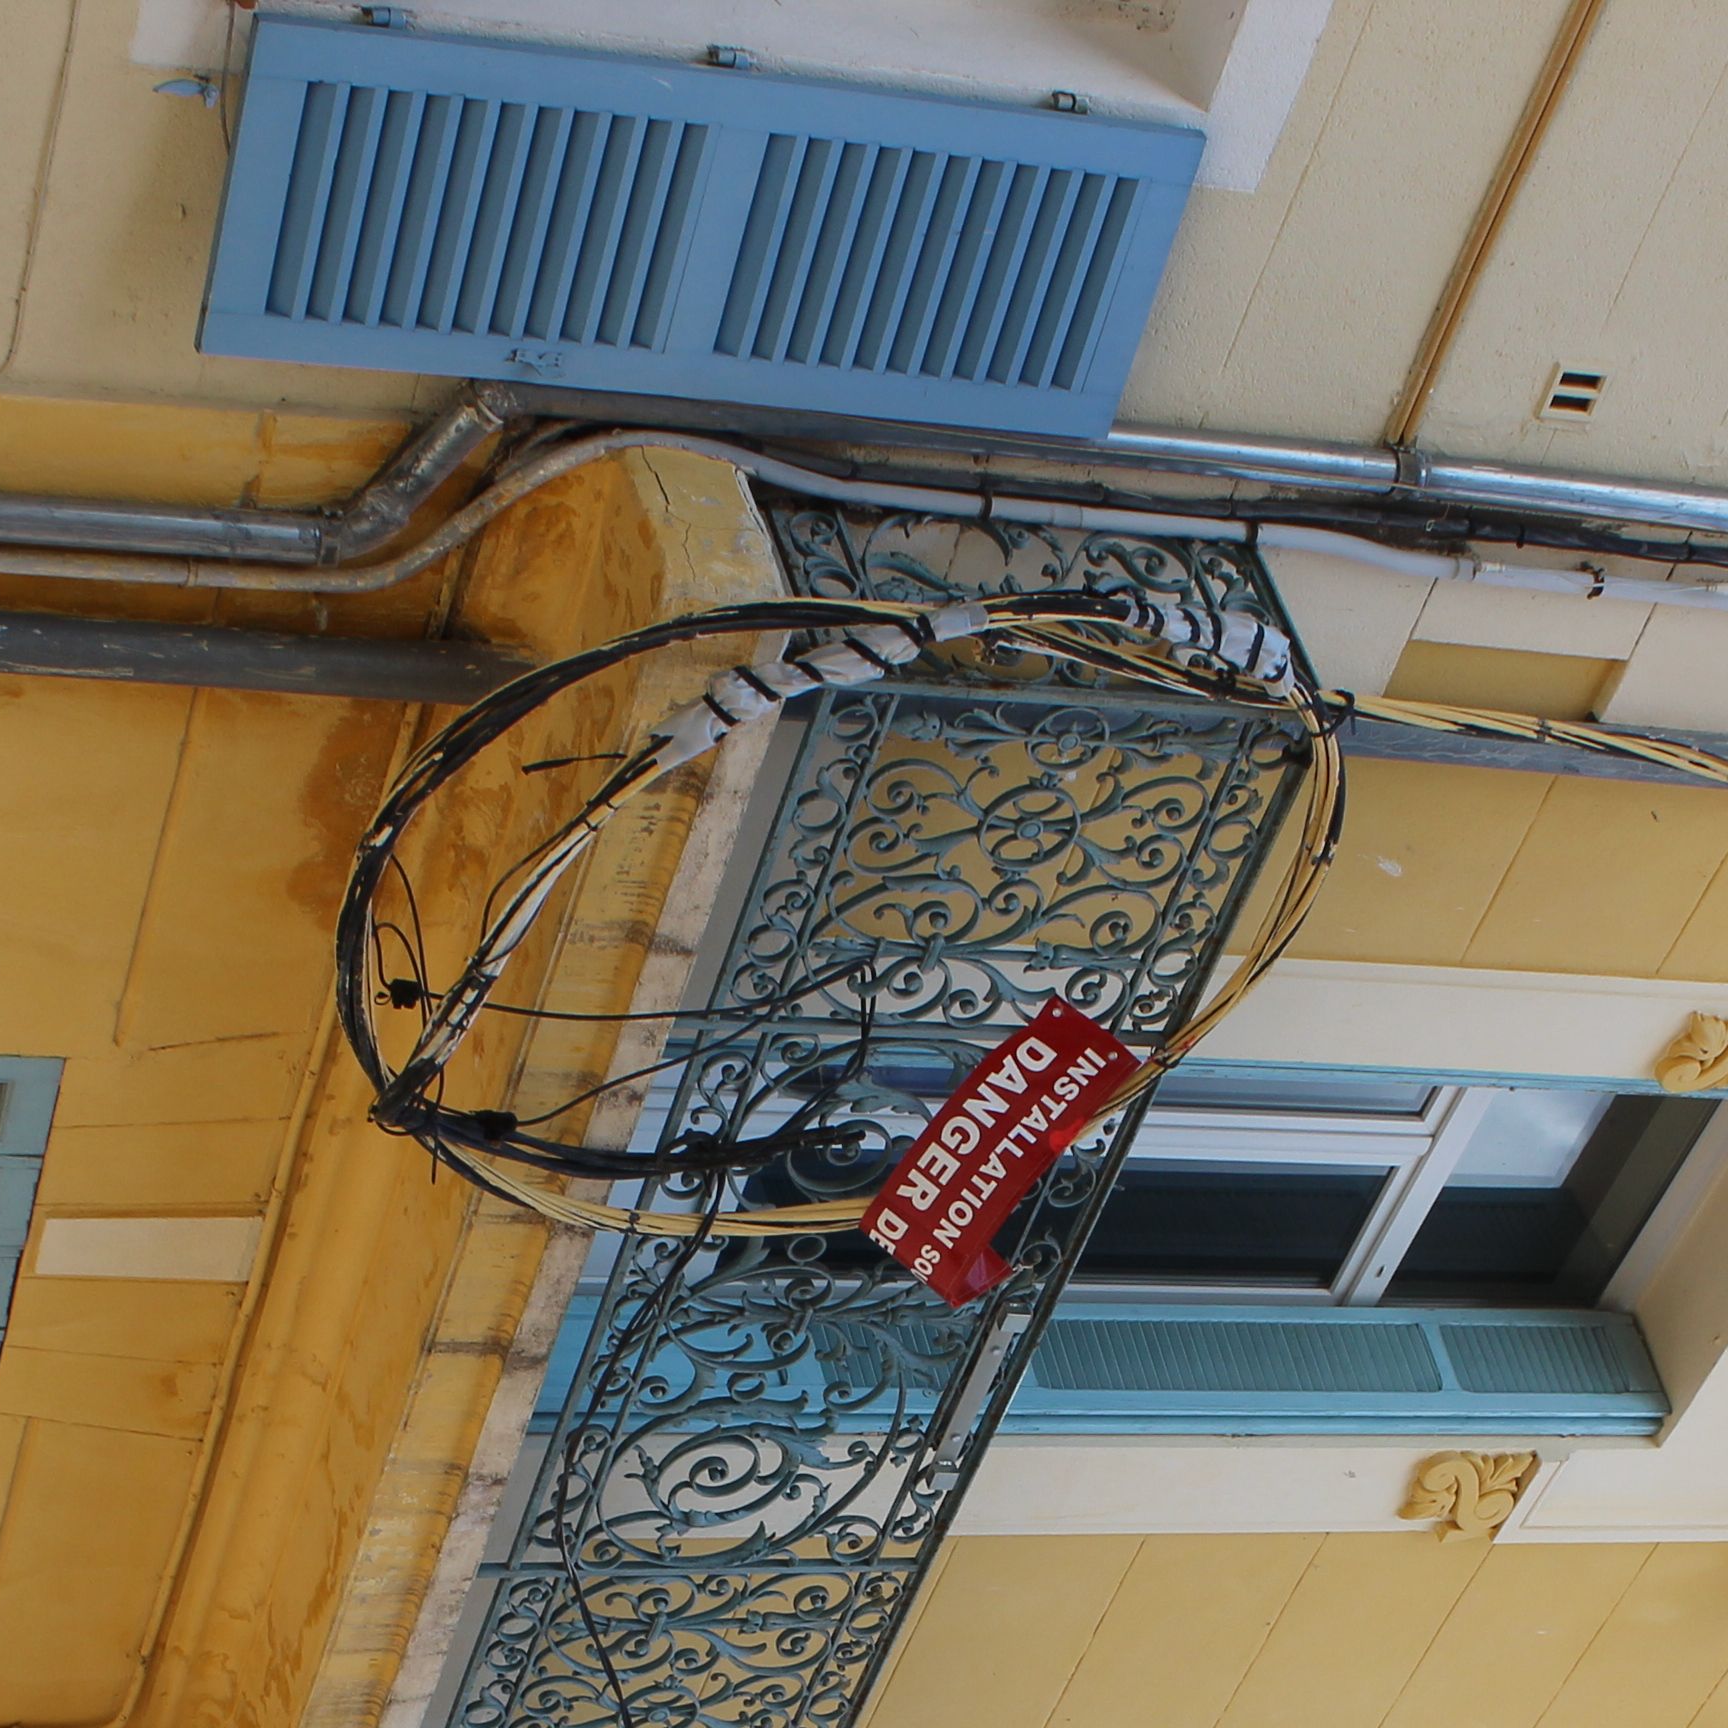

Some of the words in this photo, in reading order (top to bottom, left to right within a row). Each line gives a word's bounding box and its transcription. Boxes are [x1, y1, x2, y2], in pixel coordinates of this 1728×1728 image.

[896, 1036, 1058, 1212] DANGER
[932, 1047, 1107, 1249] INSTALLATION
[868, 1207, 909, 1255] DE
